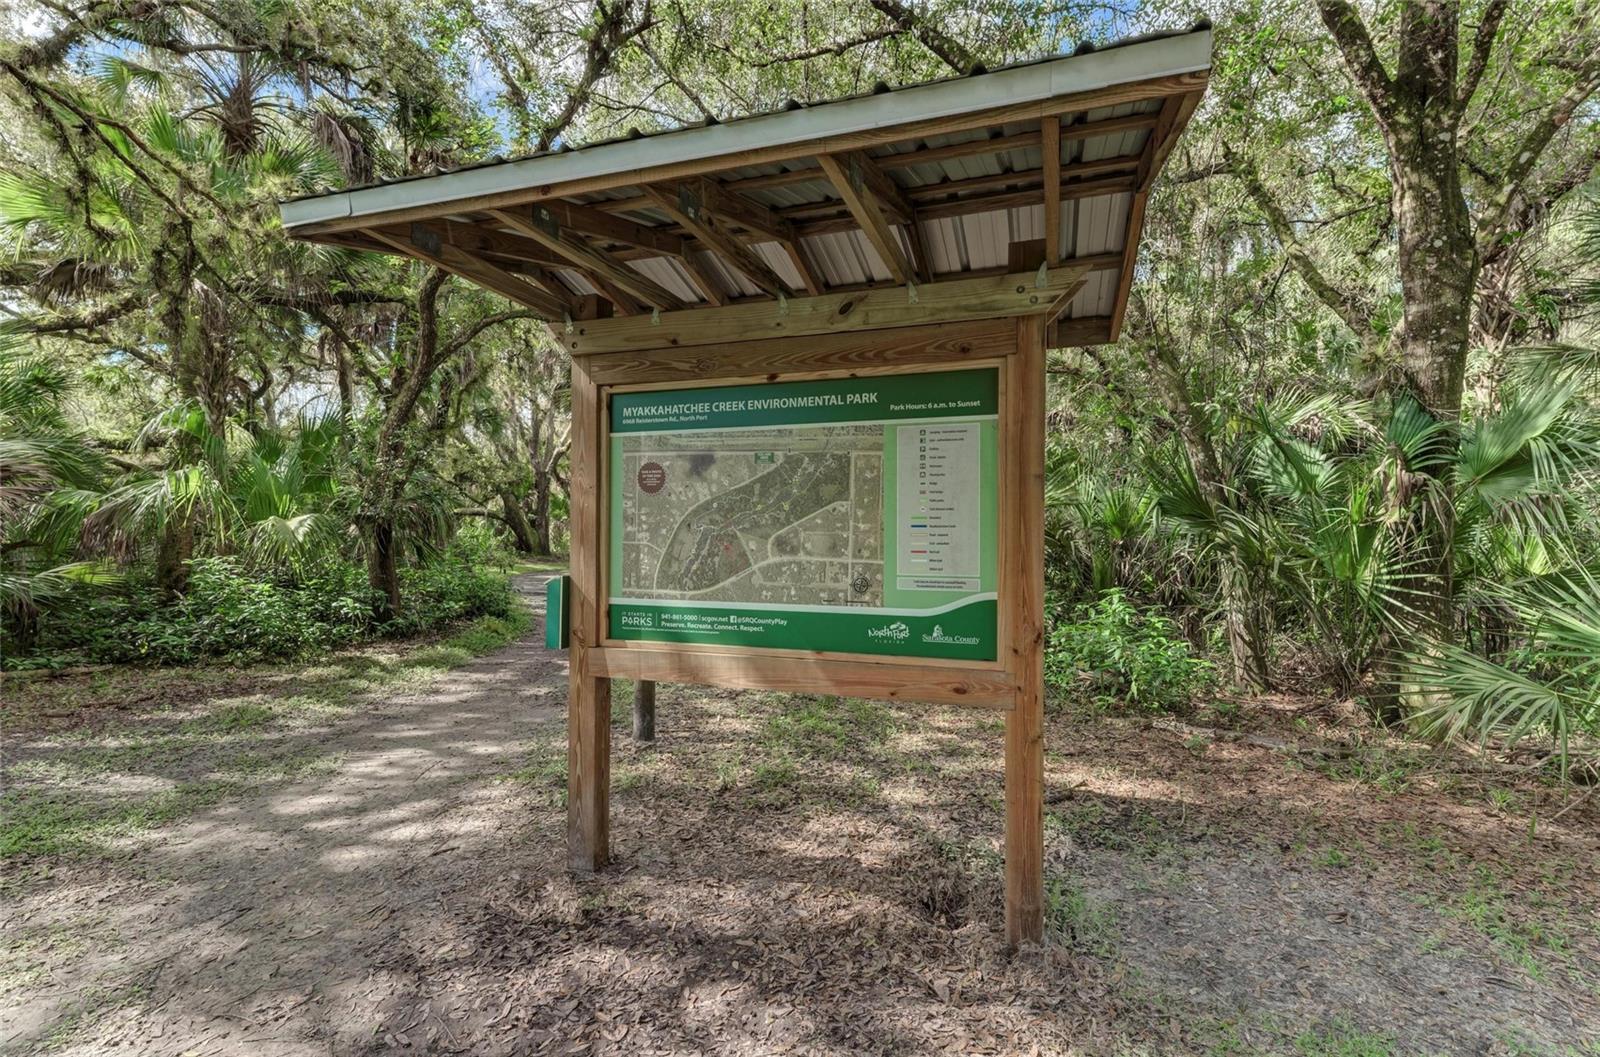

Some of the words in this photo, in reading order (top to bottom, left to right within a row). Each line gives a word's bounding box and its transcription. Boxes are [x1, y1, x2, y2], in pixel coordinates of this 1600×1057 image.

[622, 403, 710, 417] MYAKKAHATCHEE
[712, 400, 745, 413] CREEK
[747, 395, 844, 410] ENVIRONMENTAL
[846, 393, 878, 404] PARK
[957, 400, 981, 408] Sunset
[622, 616, 652, 626] PARKS
[713, 623, 739, 631] Connect.
[740, 624, 765, 632] Respect.
[954, 635, 979, 645] County
